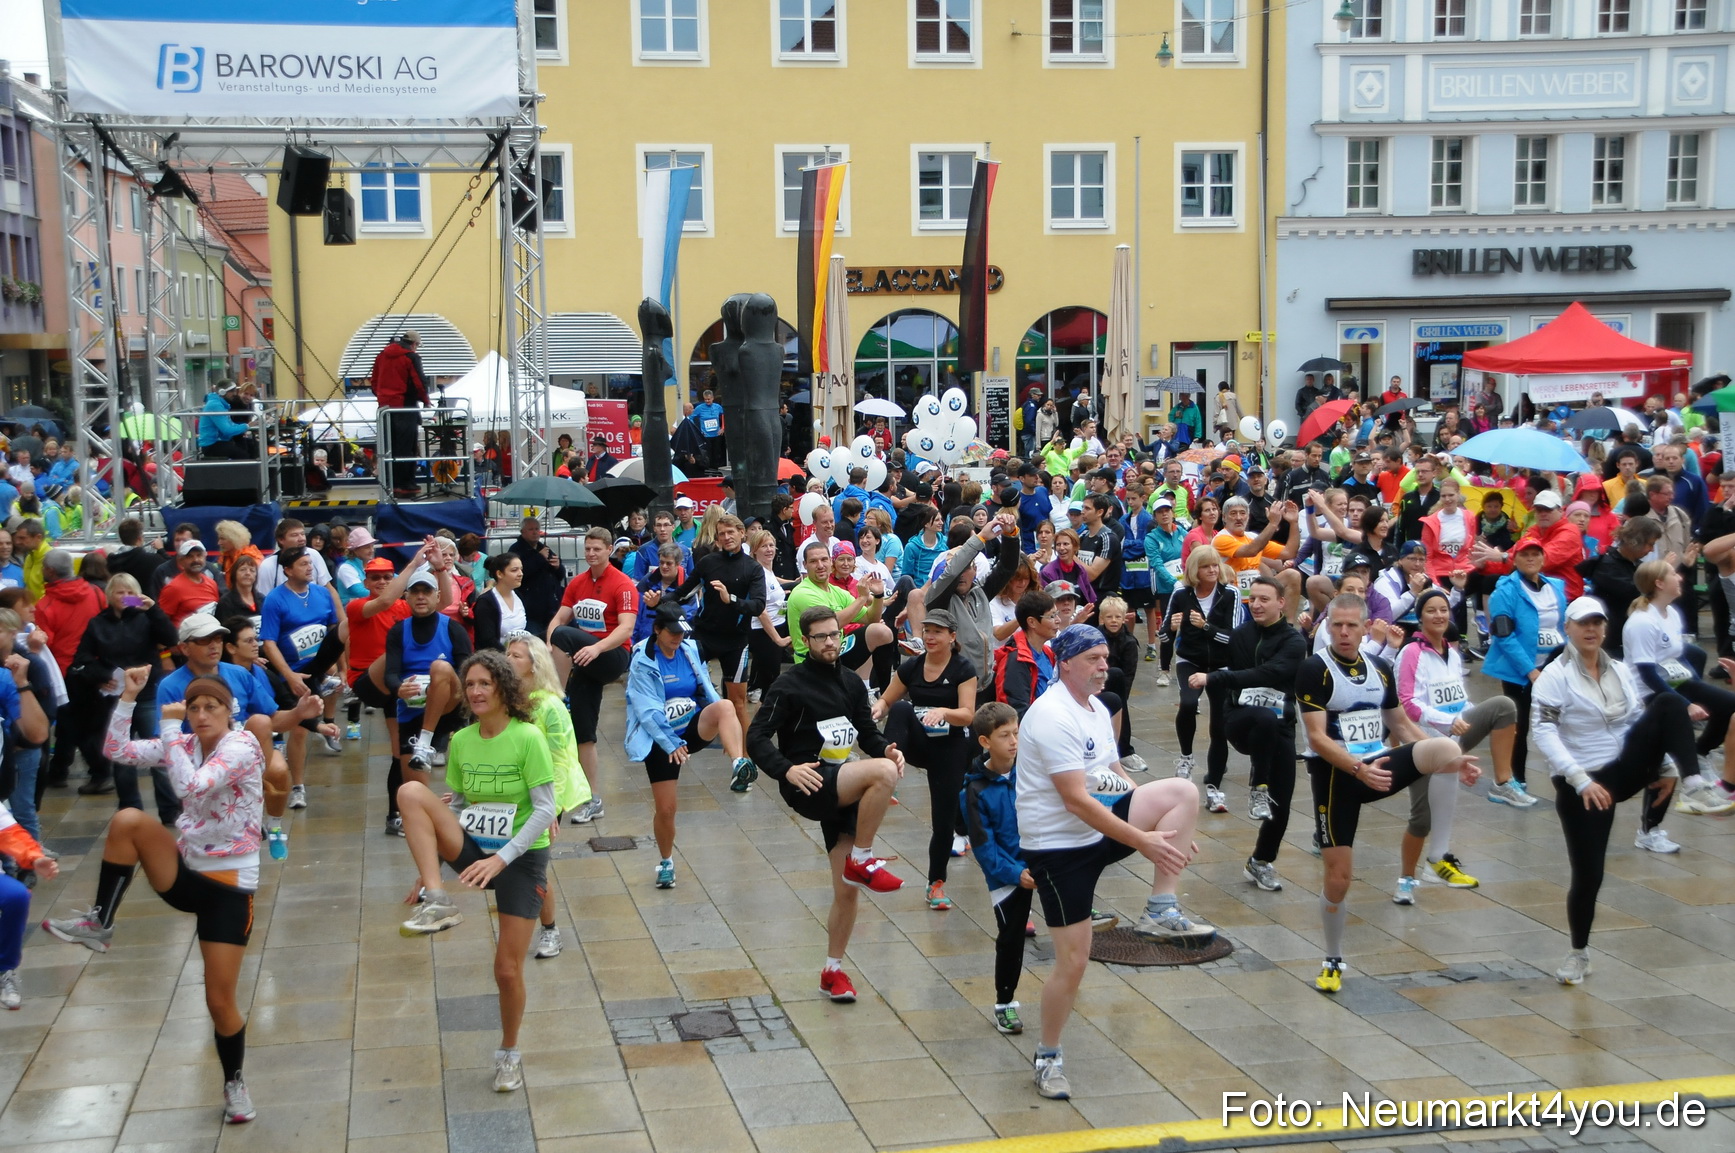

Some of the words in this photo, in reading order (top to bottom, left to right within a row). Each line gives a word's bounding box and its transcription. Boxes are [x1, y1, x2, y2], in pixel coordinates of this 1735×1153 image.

[215, 53, 383, 80] BAROWSKI
[393, 55, 438, 81] AG
[217, 81, 313, 95] Veranstaltungs-
[317, 82, 340, 93] und
[344, 83, 437, 96] Mediensysteme
[1440, 73, 1535, 98] BRILLEN
[1540, 71, 1629, 96] WEBER
[1412, 247, 1524, 275] BRILLEN
[1529, 244, 1637, 272] WEBER
[1421, 325, 1461, 337] BRILLEN
[1463, 325, 1500, 336] WEBER
[1242, 352, 1254, 360] 24
[576, 606, 601, 620] 2098
[298, 628, 326, 649] 3124
[1434, 685, 1464, 704] 3029
[832, 727, 854, 746] 576
[1348, 721, 1380, 742] 2132
[482, 806, 507, 814] Neumarkt
[465, 813, 508, 836] 2412
